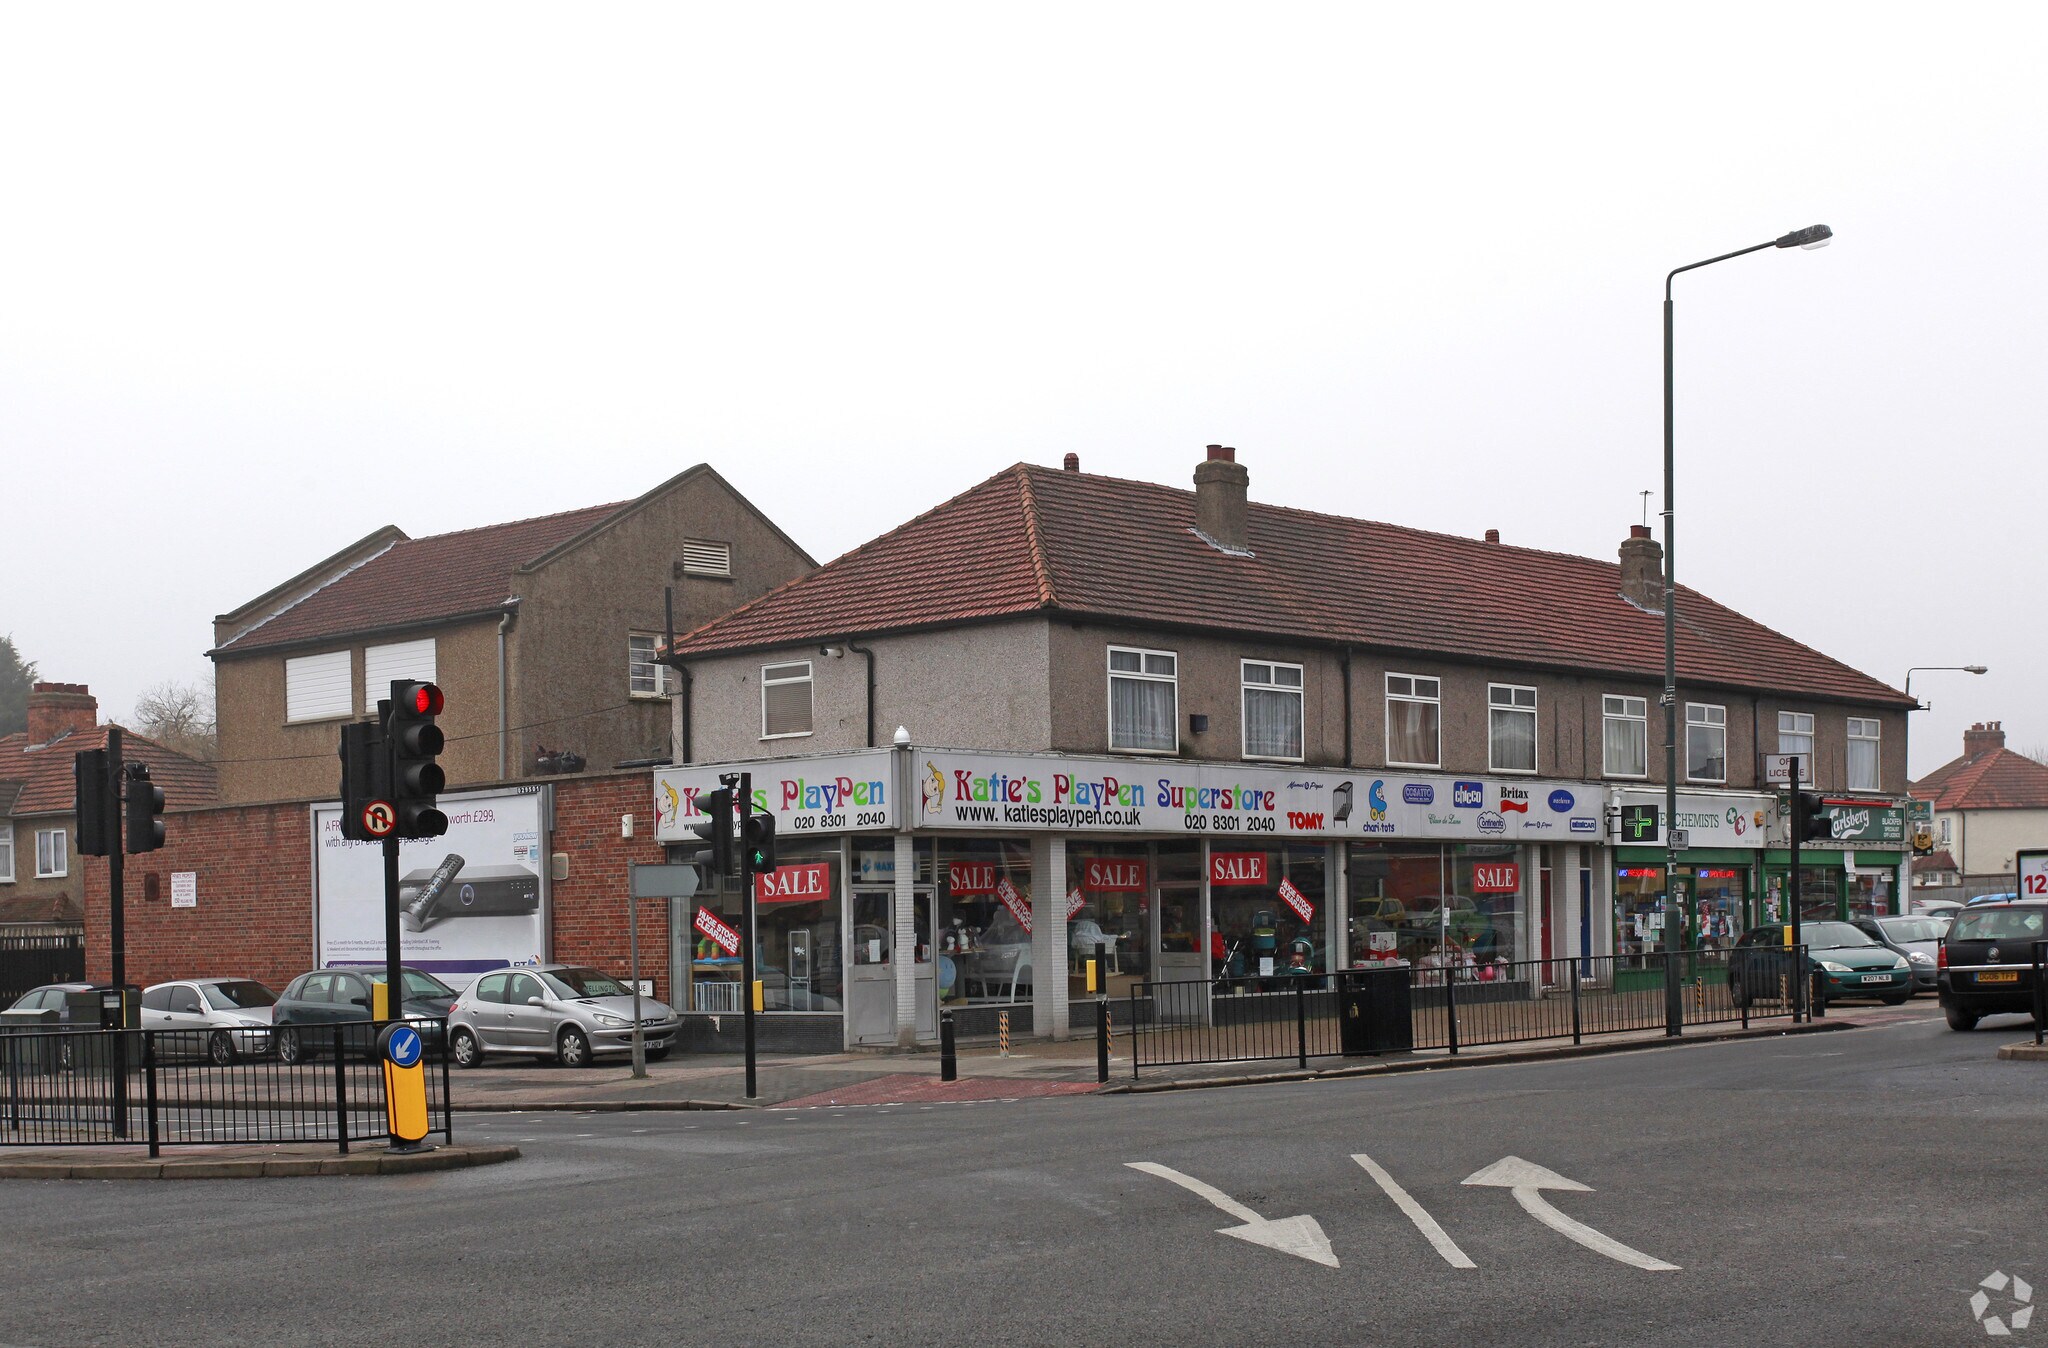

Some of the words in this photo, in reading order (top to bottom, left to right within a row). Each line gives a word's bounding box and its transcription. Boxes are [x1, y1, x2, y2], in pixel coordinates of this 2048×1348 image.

[780, 776, 885, 814] PlayPen
[954, 769, 1042, 804] Katie's
[1053, 773, 1146, 812] PlayPen
[1157, 779, 1275, 815] Superstore
[1455, 784, 1482, 804] chicco
[1500, 786, 1529, 798] Britax
[450, 812, 472, 824] worth
[794, 816, 815, 829] 020
[820, 814, 846, 828] 8301
[856, 811, 886, 826] 2040
[1004, 803, 1141, 827] katiesplaypen.co.uk
[1184, 814, 1207, 830] 020
[1213, 815, 1240, 831] 8301
[1247, 816, 1275, 832] 2040
[1676, 812, 1720, 828] CHEMISTS
[1830, 807, 1869, 838] Carlsberg
[950, 866, 994, 890] SALE
[1090, 864, 1140, 886] SALE
[1215, 857, 1262, 880] SALE
[1478, 868, 1514, 888] SALE
[764, 869, 822, 896] SALE
[1000, 879, 1018, 900] HUGE
[1016, 898, 1032, 922] STOC
[1280, 886, 1312, 922] CLEARANCE
[1282, 880, 1296, 898] HUGE
[1296, 894, 1312, 914] STOCK
[696, 918, 738, 954] CLEARANCE
[699, 910, 717, 928] HUGE
[716, 924, 738, 945] STOCK
